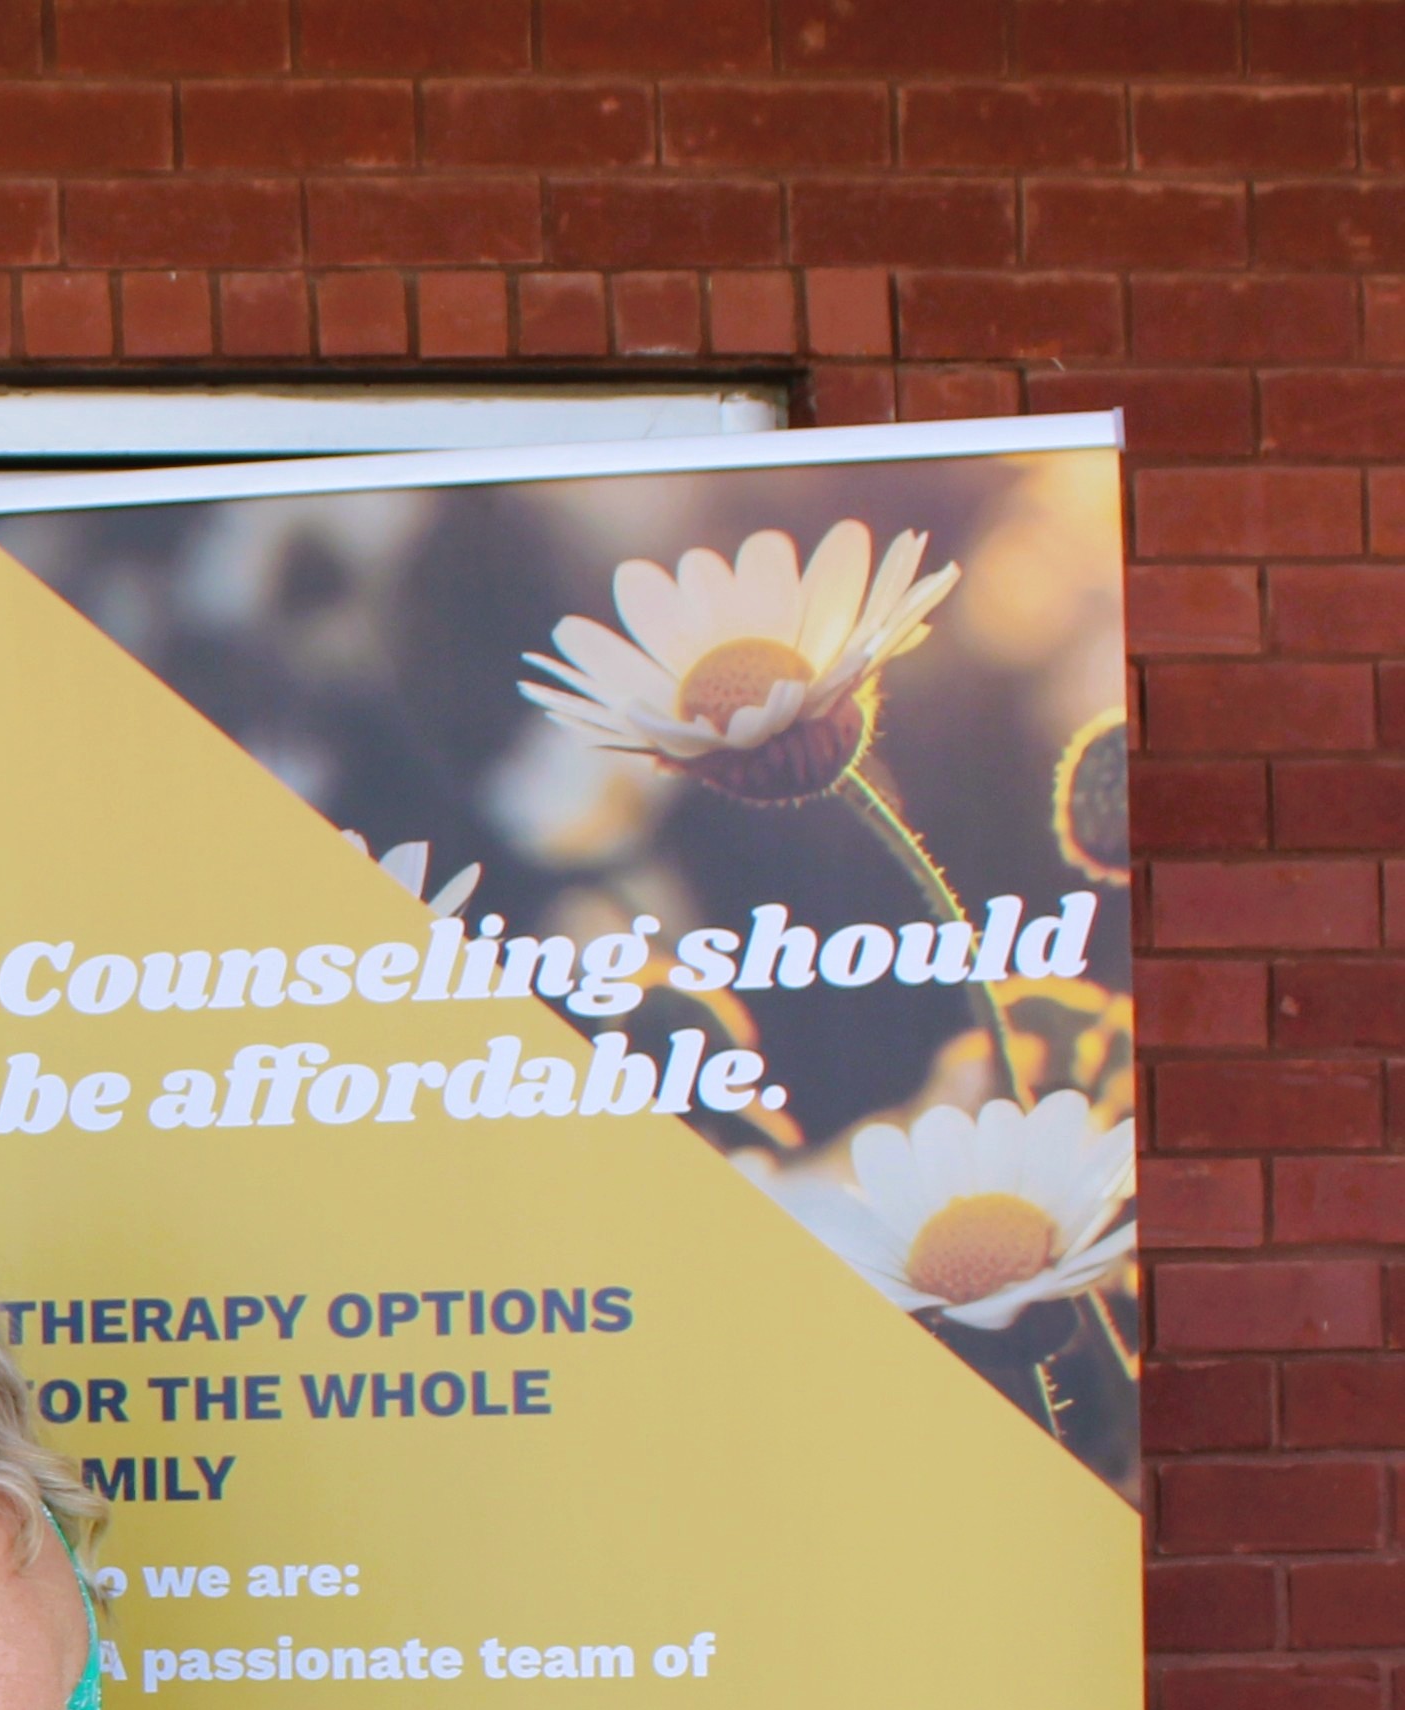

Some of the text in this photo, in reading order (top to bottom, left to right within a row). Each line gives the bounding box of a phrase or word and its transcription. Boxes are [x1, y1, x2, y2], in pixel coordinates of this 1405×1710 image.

[670, 891, 1096, 990] should
[149, 1031, 789, 1128] affordable.
[327, 1287, 634, 1338] OPTIONS
[25, 1369, 553, 1424] OR THE WHOLE
[81, 1456, 237, 1502] MILY
[142, 1565, 231, 1598] we
[247, 1563, 360, 1598] are:
[143, 1635, 464, 1694] passionate
[479, 1637, 636, 1679] team
[652, 1632, 716, 1678] of
